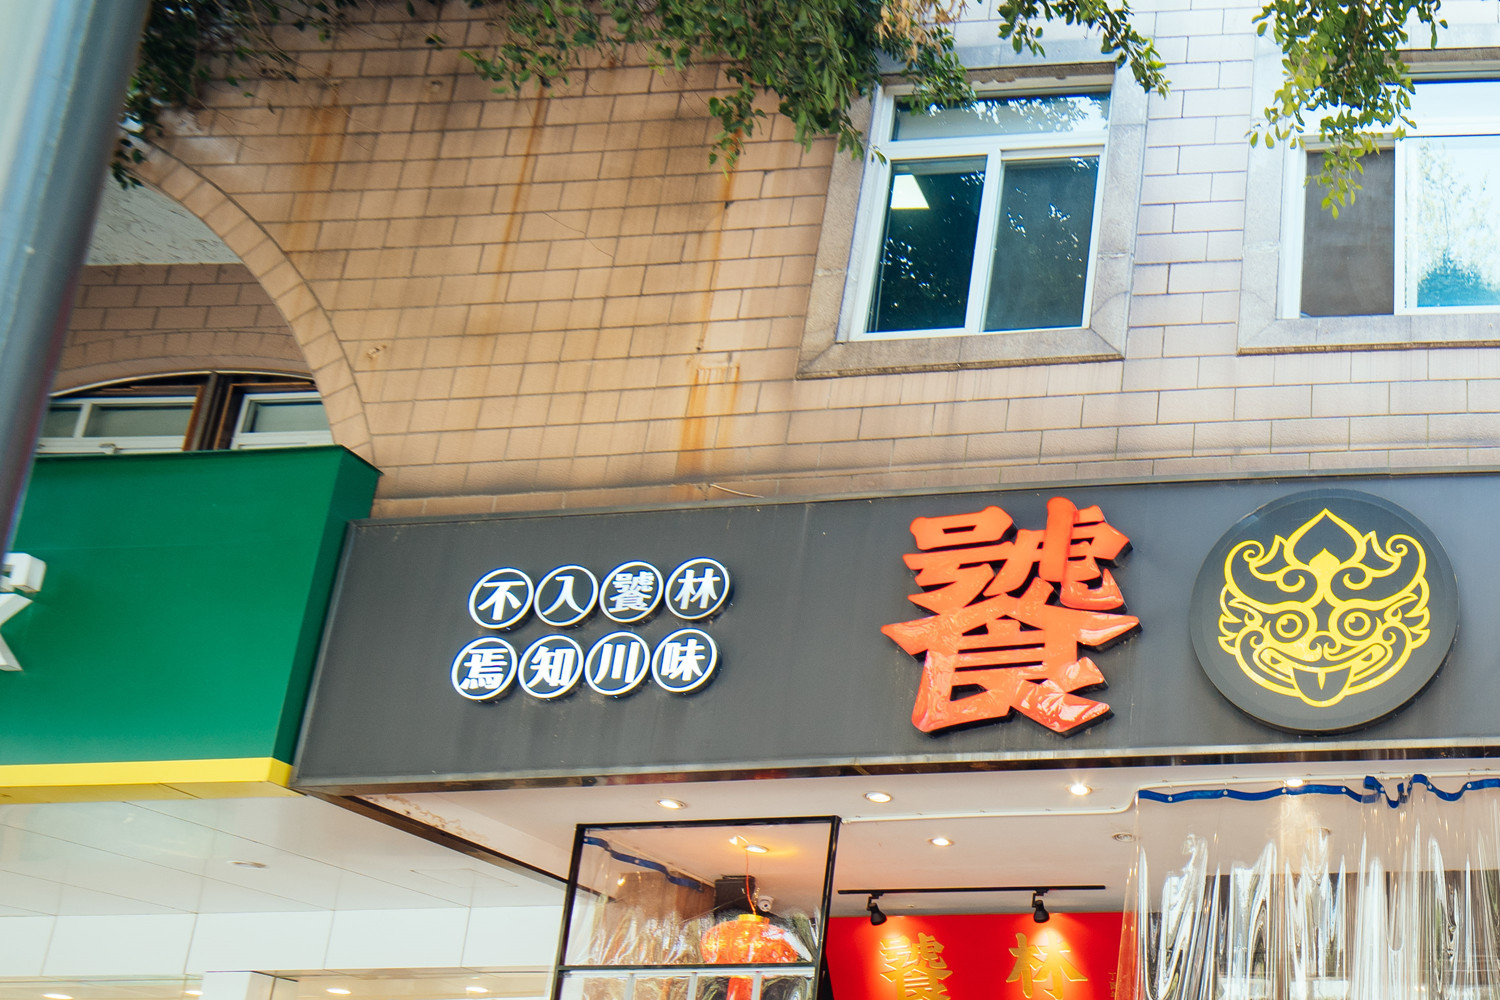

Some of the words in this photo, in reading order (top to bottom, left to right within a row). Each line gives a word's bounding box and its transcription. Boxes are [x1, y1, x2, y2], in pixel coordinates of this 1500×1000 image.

[472, 561, 725, 625] 不入饕林
[882, 497, 1139, 734] 饕
[455, 632, 712, 697] 焉知川味
